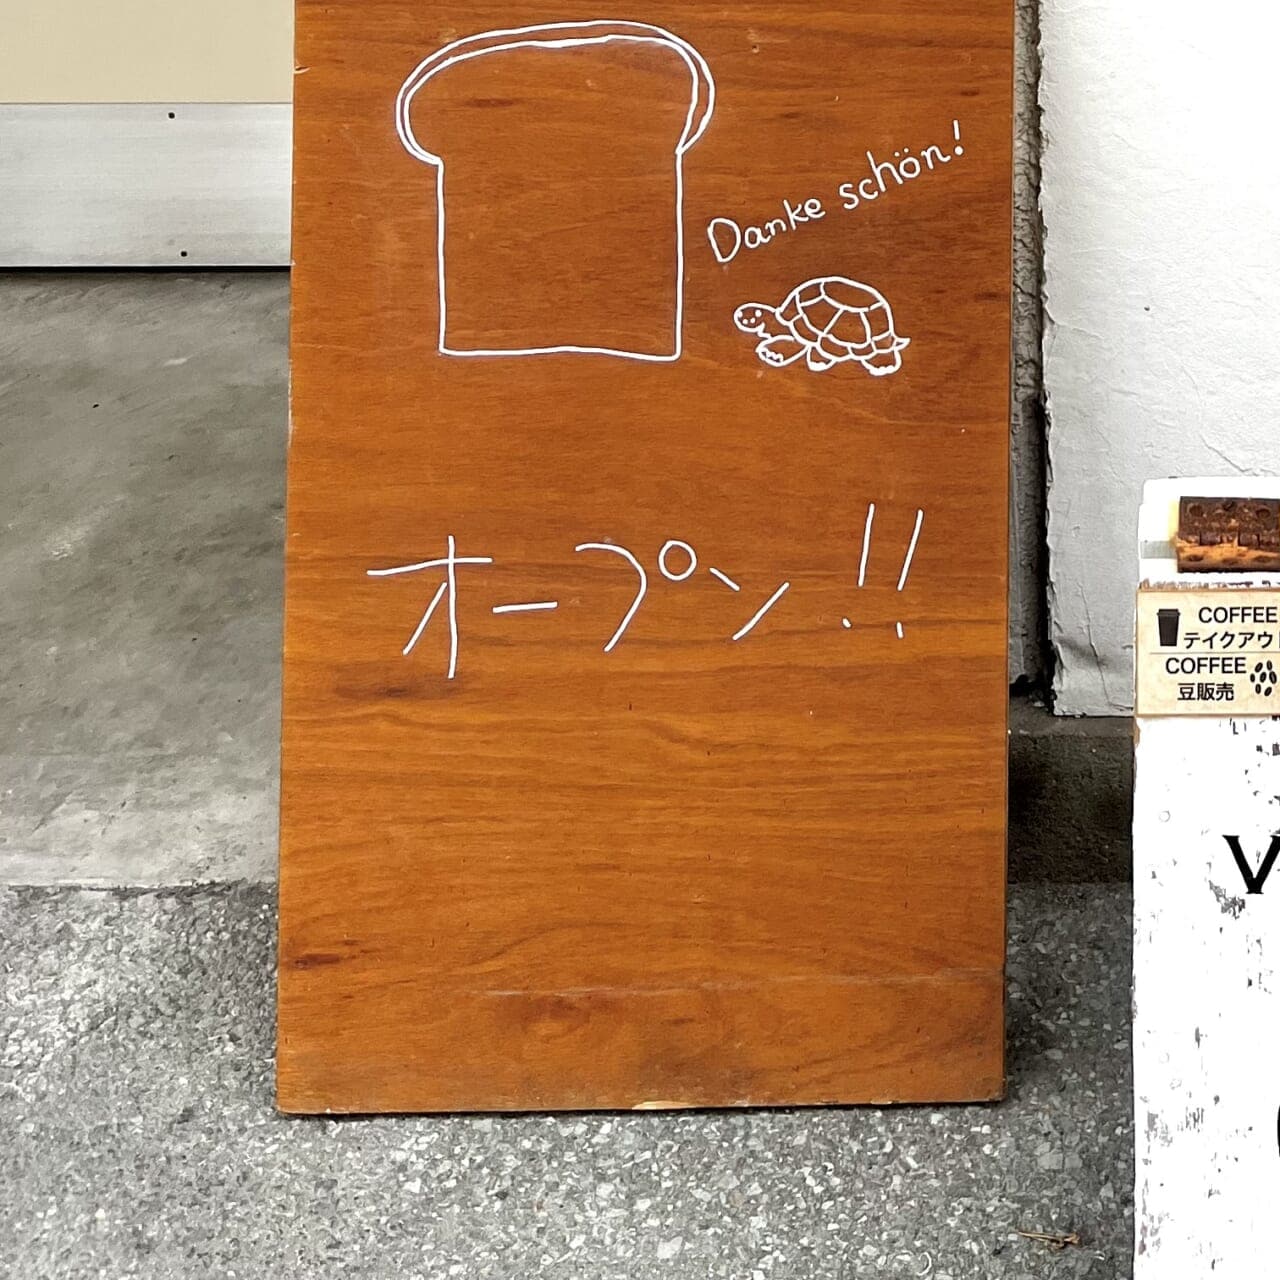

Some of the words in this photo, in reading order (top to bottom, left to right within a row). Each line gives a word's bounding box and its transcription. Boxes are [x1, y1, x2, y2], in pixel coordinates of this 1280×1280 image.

[707, 198, 826, 263] Danke
[839, 119, 964, 210] schön!
[1198, 606, 1278, 624] COFFEE
[1165, 656, 1247, 675] COFFEE
[1177, 681, 1235, 702] 豆販売
